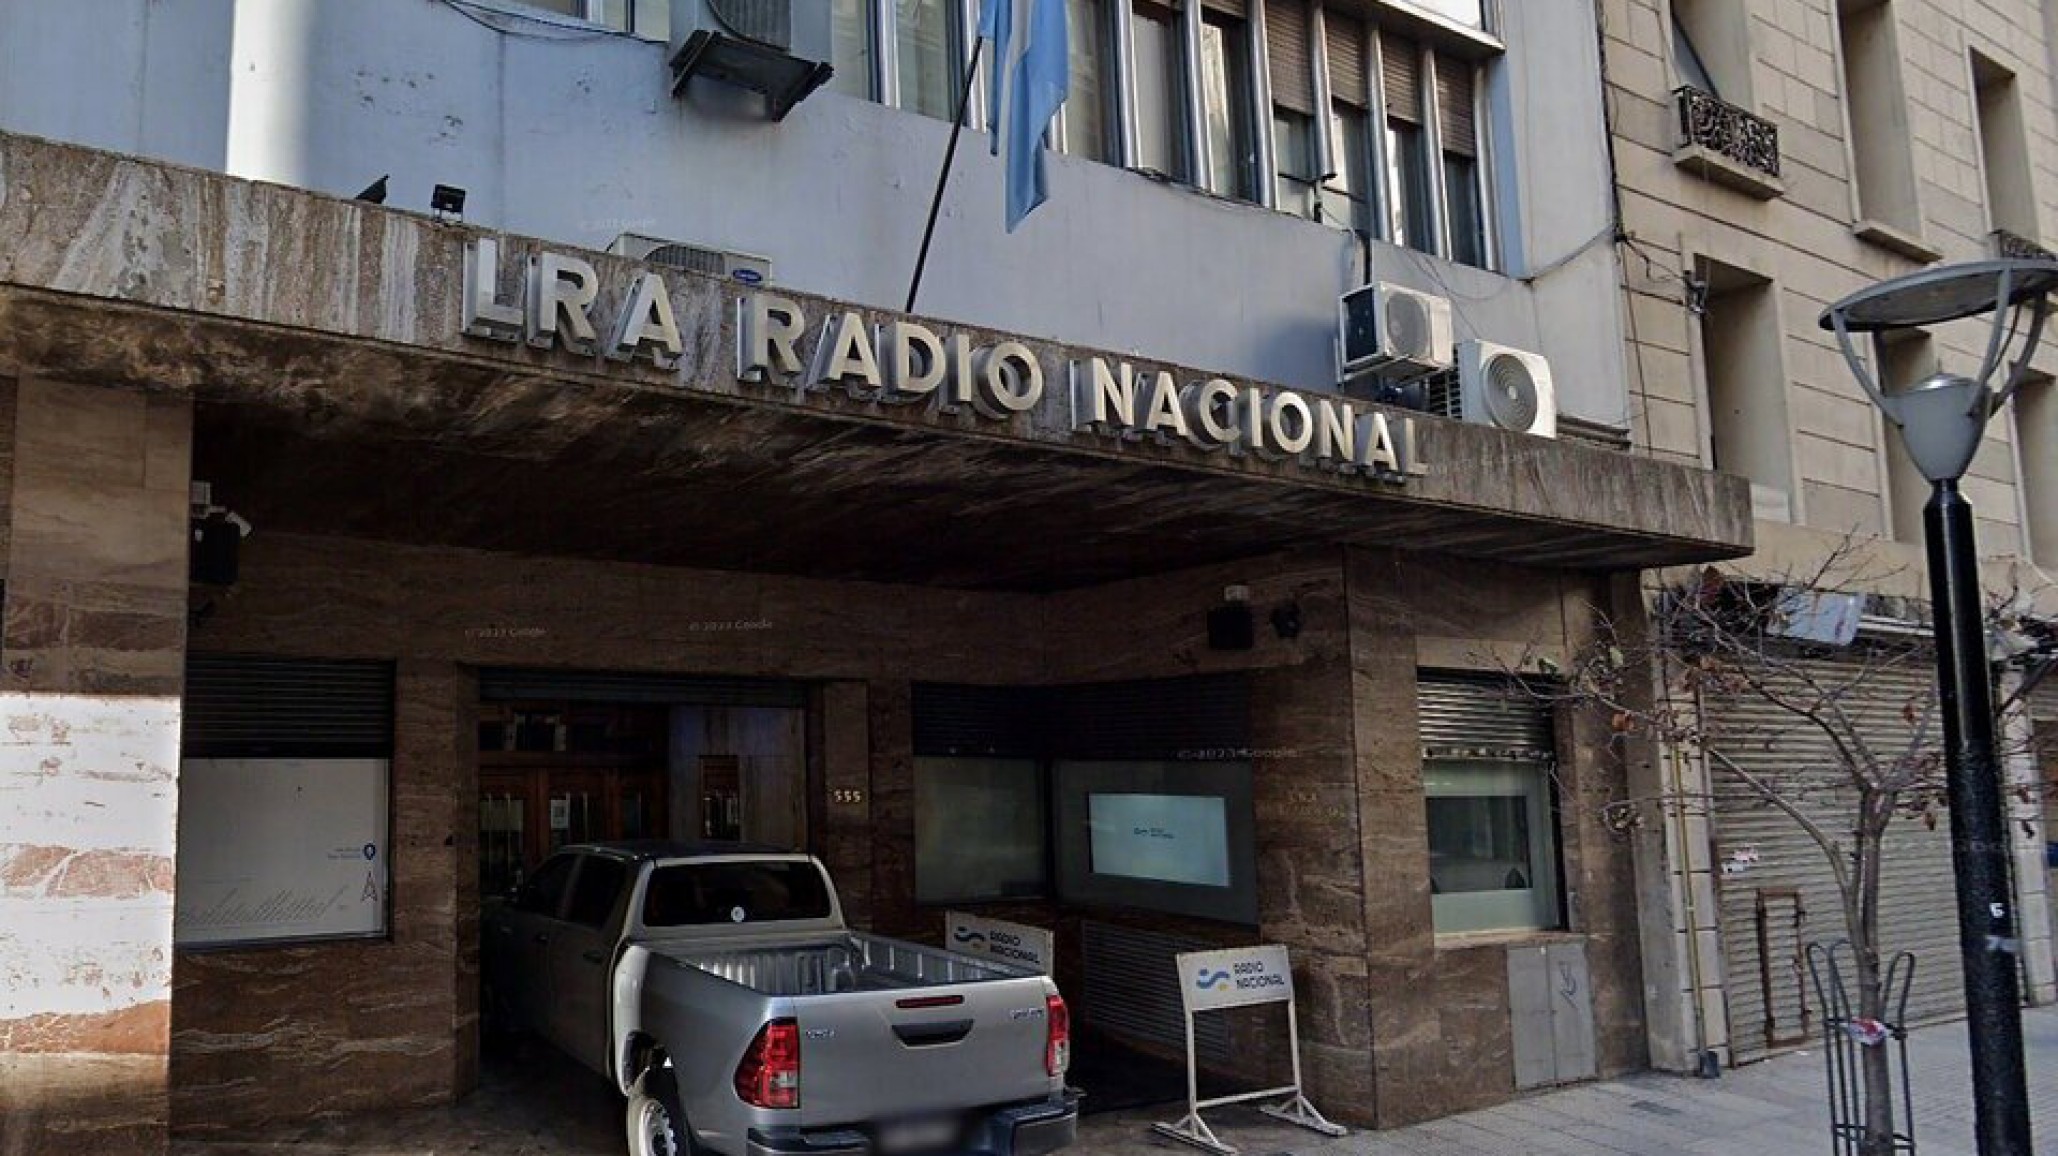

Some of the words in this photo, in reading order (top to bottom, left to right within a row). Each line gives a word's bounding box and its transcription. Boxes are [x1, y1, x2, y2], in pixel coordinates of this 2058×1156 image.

[464, 237, 683, 355] LRA
[739, 291, 1043, 412] RADIO
[1074, 357, 1430, 477] NACIONAL
[834, 789, 861, 803] 555
[990, 930, 1021, 946] RADIO
[990, 943, 1040, 965] NACIONAL
[1233, 960, 1264, 975] RADIO
[1236, 973, 1285, 990] NACIONAL
